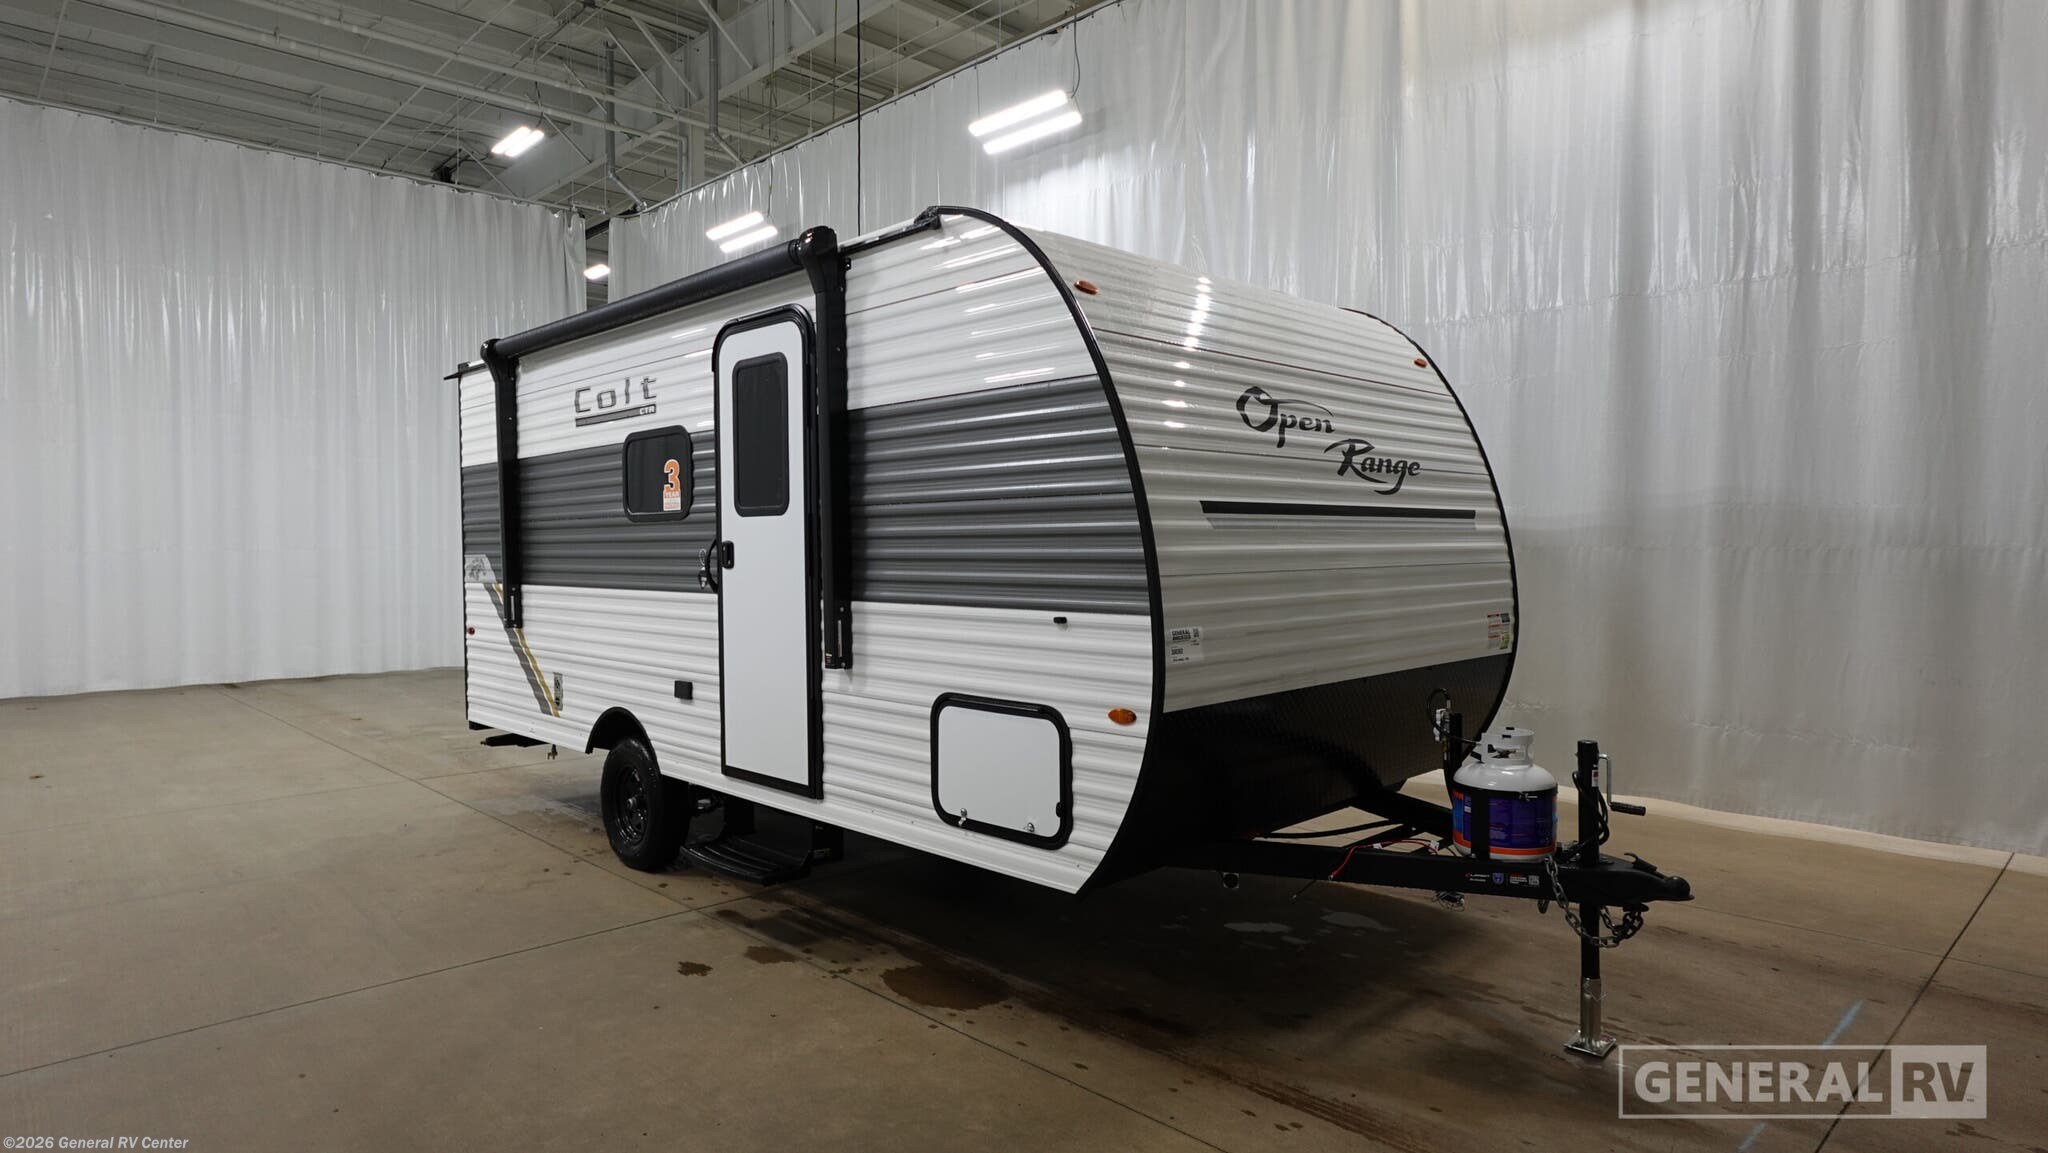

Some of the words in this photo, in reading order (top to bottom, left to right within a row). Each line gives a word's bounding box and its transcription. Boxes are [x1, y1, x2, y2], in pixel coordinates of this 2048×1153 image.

[574, 376, 657, 413] Colt
[639, 405, 656, 415] CTR
[1236, 386, 1335, 449] Open
[663, 459, 681, 493] 3
[1323, 438, 1421, 496] Range
